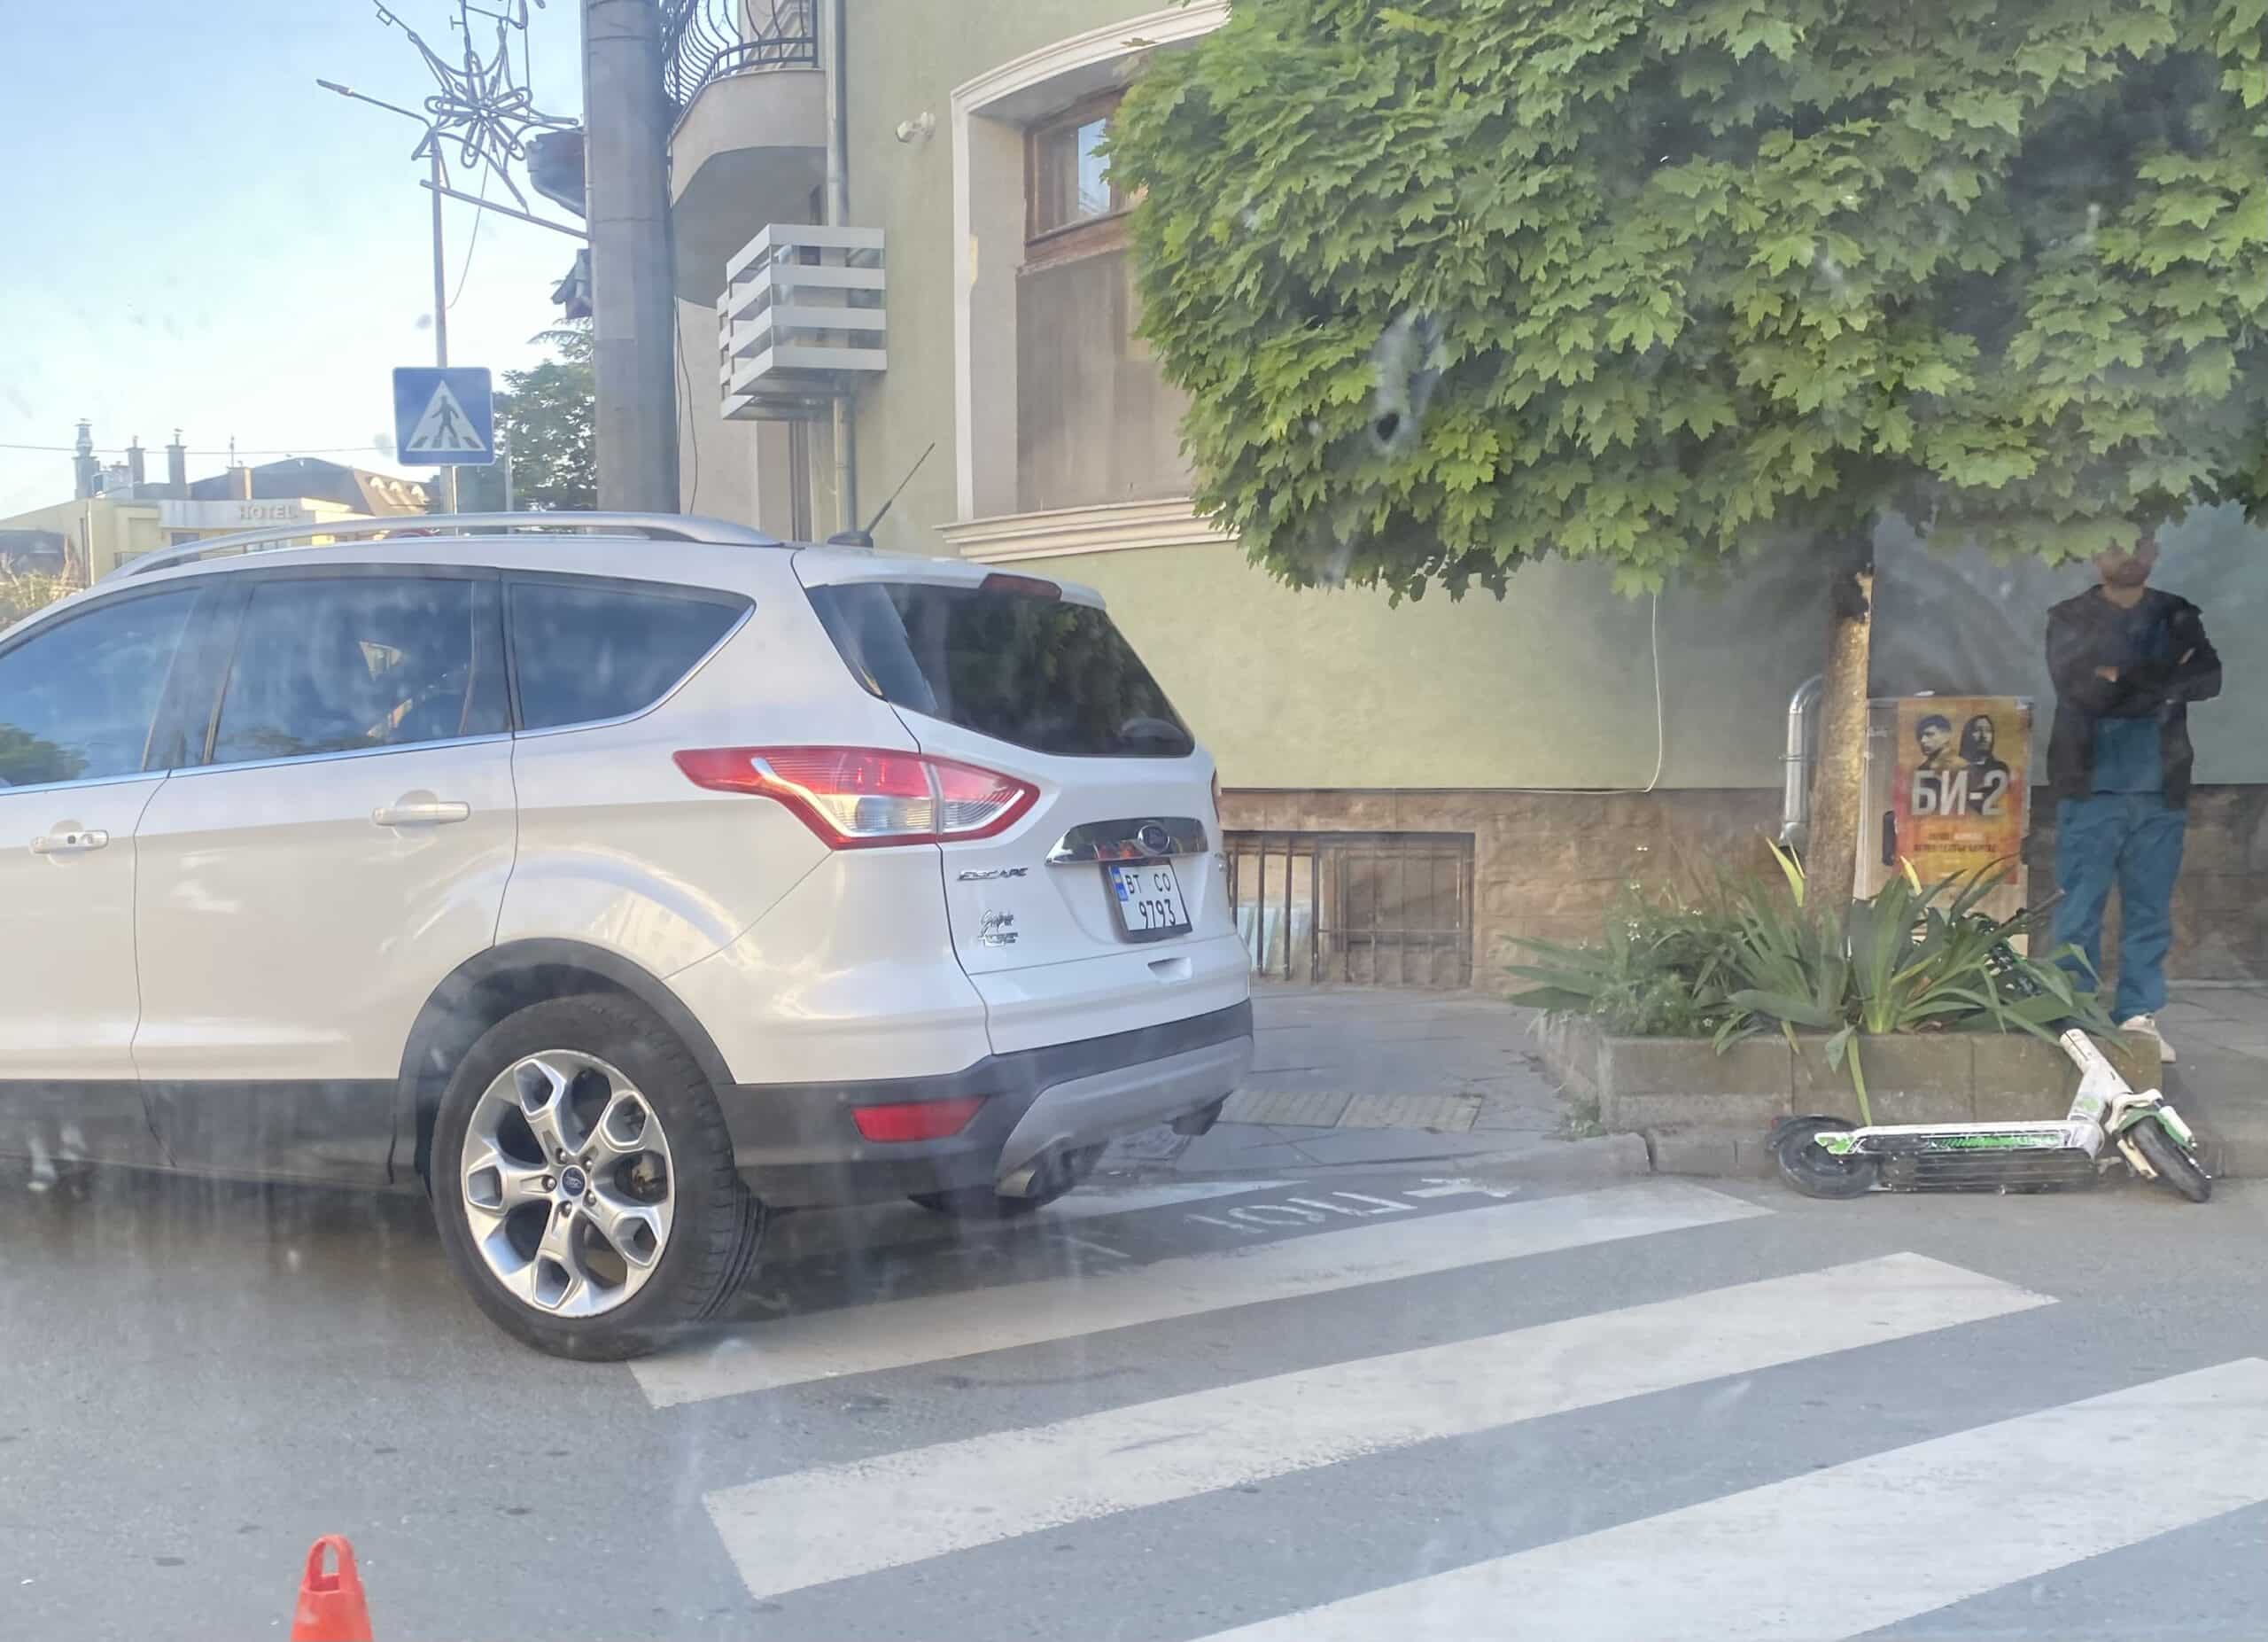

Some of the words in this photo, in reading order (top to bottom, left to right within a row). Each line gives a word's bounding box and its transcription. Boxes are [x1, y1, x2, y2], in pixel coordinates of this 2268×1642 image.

[239, 504, 298, 520] HOTEL
[1912, 769, 2009, 815] БИ-2
[1125, 874, 1142, 894] BT
[1153, 873, 1171, 892] CO
[1138, 899, 1177, 930] 9793
